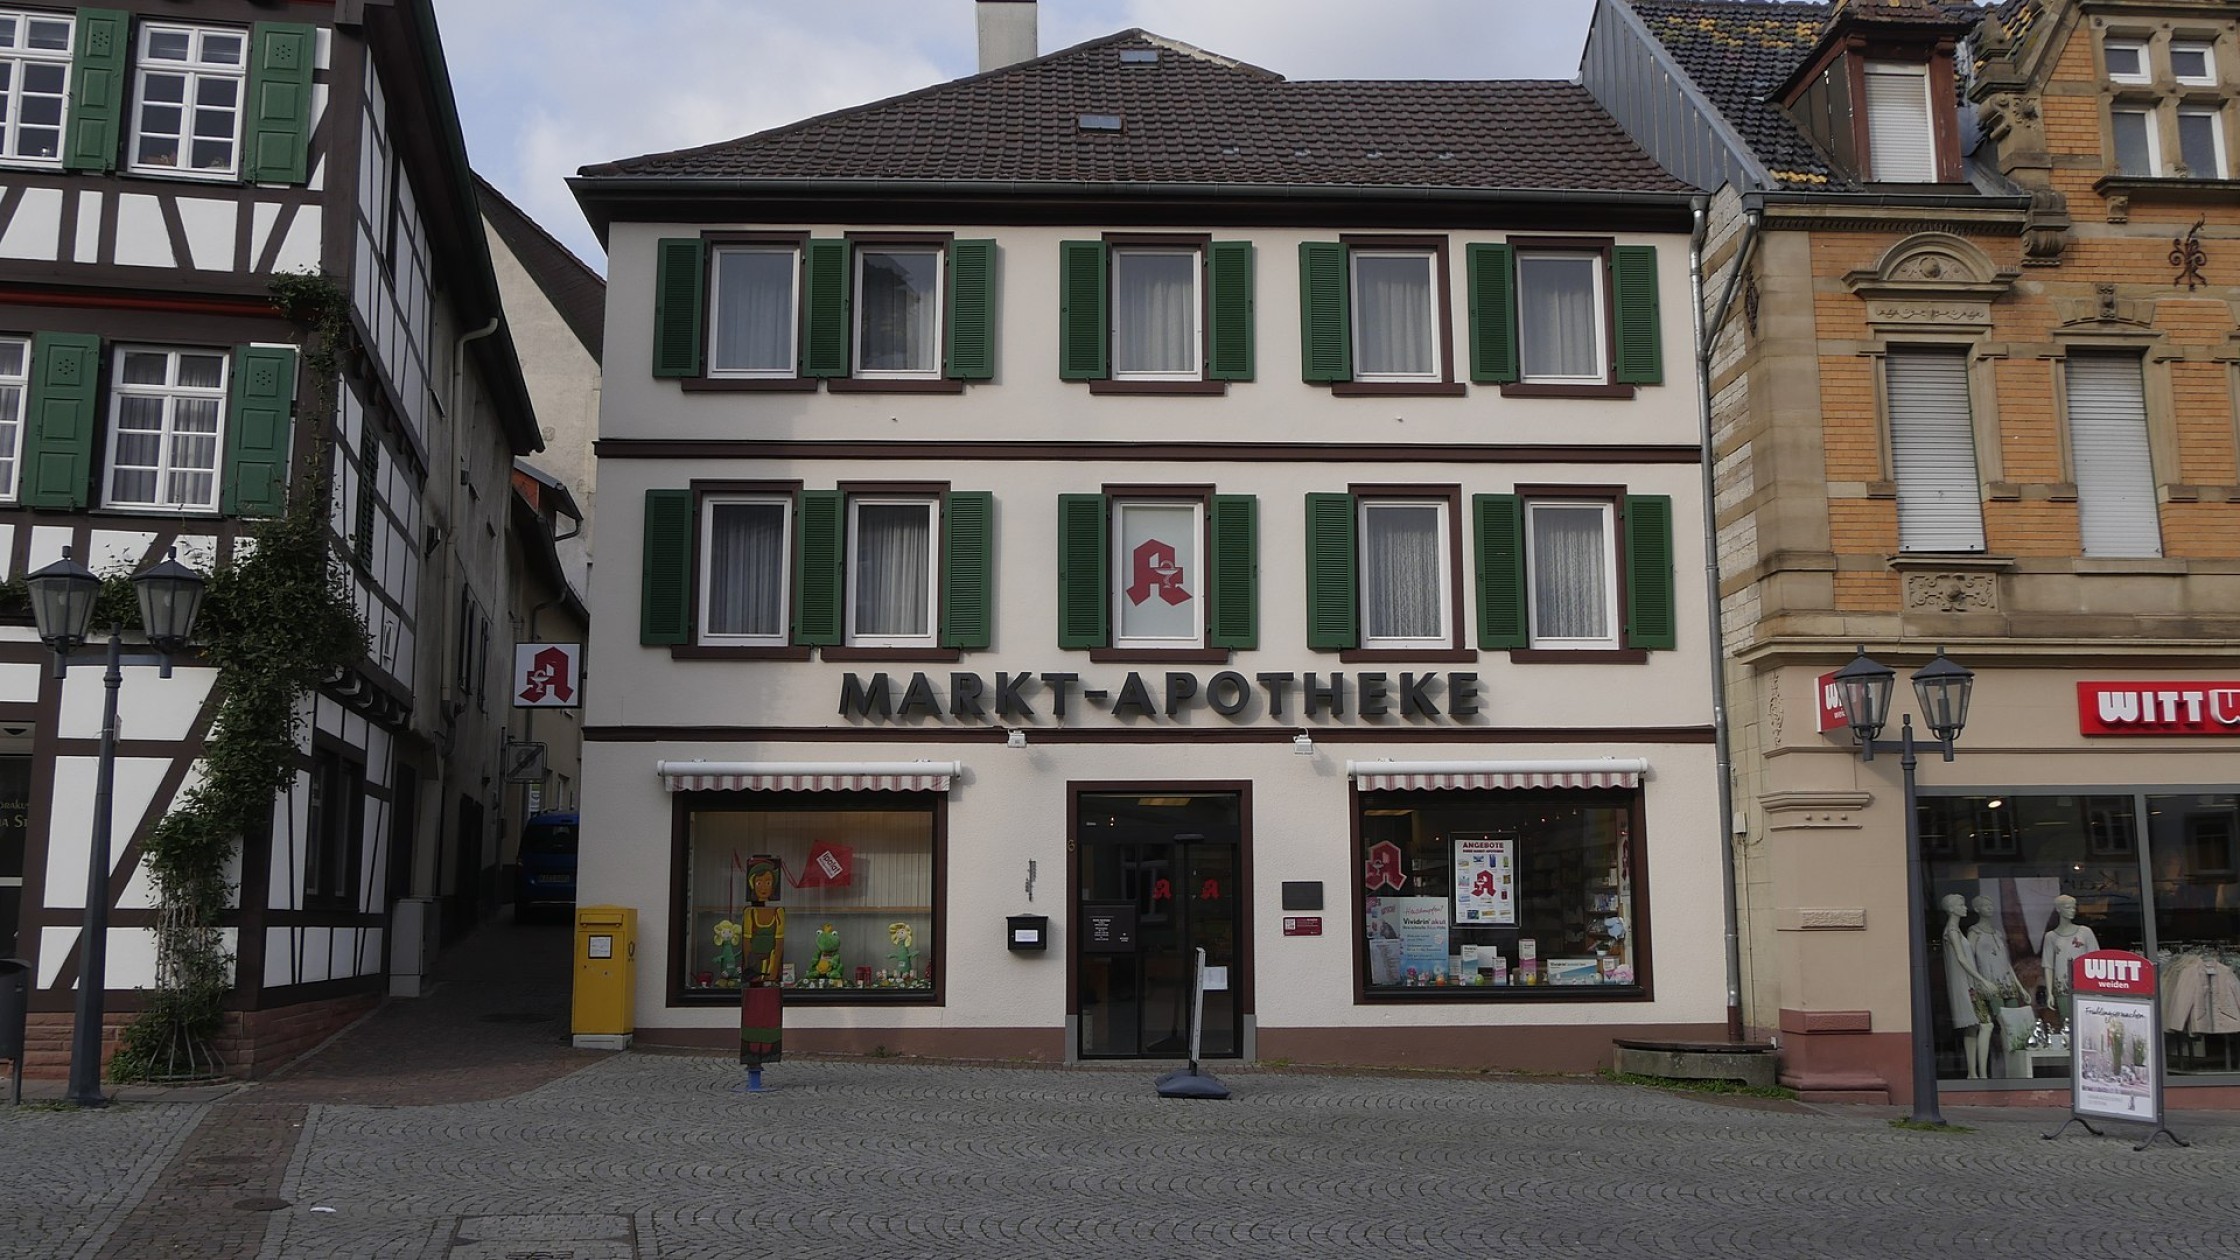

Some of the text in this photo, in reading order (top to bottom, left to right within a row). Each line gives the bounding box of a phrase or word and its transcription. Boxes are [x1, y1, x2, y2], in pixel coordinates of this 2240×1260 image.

[839, 671, 1479, 717] MARKT-APOTHEKE
[2097, 691, 2204, 722] WITT
[1068, 839, 1075, 852] 6
[2084, 958, 2142, 981] WITT
[2098, 980, 2129, 989] weiden
